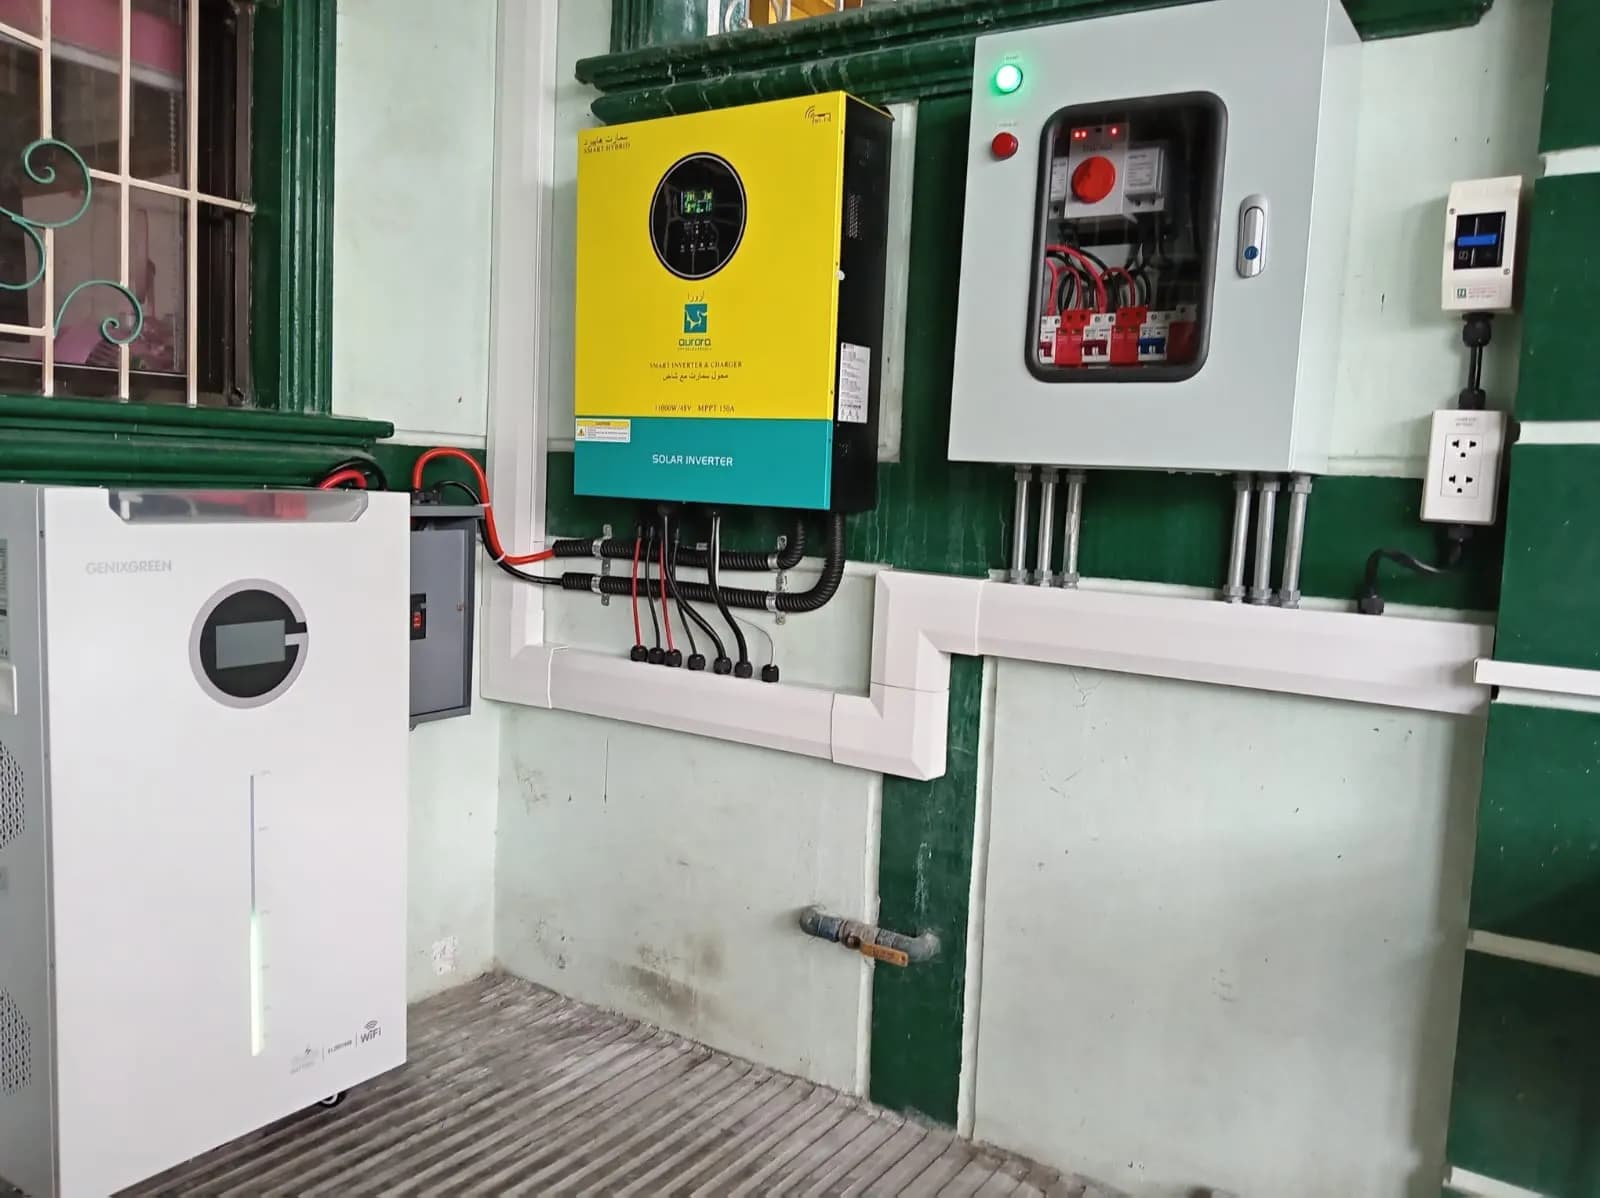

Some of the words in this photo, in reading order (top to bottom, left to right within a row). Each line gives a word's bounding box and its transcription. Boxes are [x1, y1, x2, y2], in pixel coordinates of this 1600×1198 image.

[583, 144, 604, 153] SMART
[606, 142, 630, 152] HYBRID
[678, 338, 711, 347] aurora
[710, 361, 742, 369] CHARGER
[698, 404, 717, 412] MPPT
[652, 454, 683, 465] SOLAR
[685, 455, 734, 467] INVERTER
[86, 559, 172, 575] GENIXGREEN
[360, 1027, 382, 1043] WiFi
